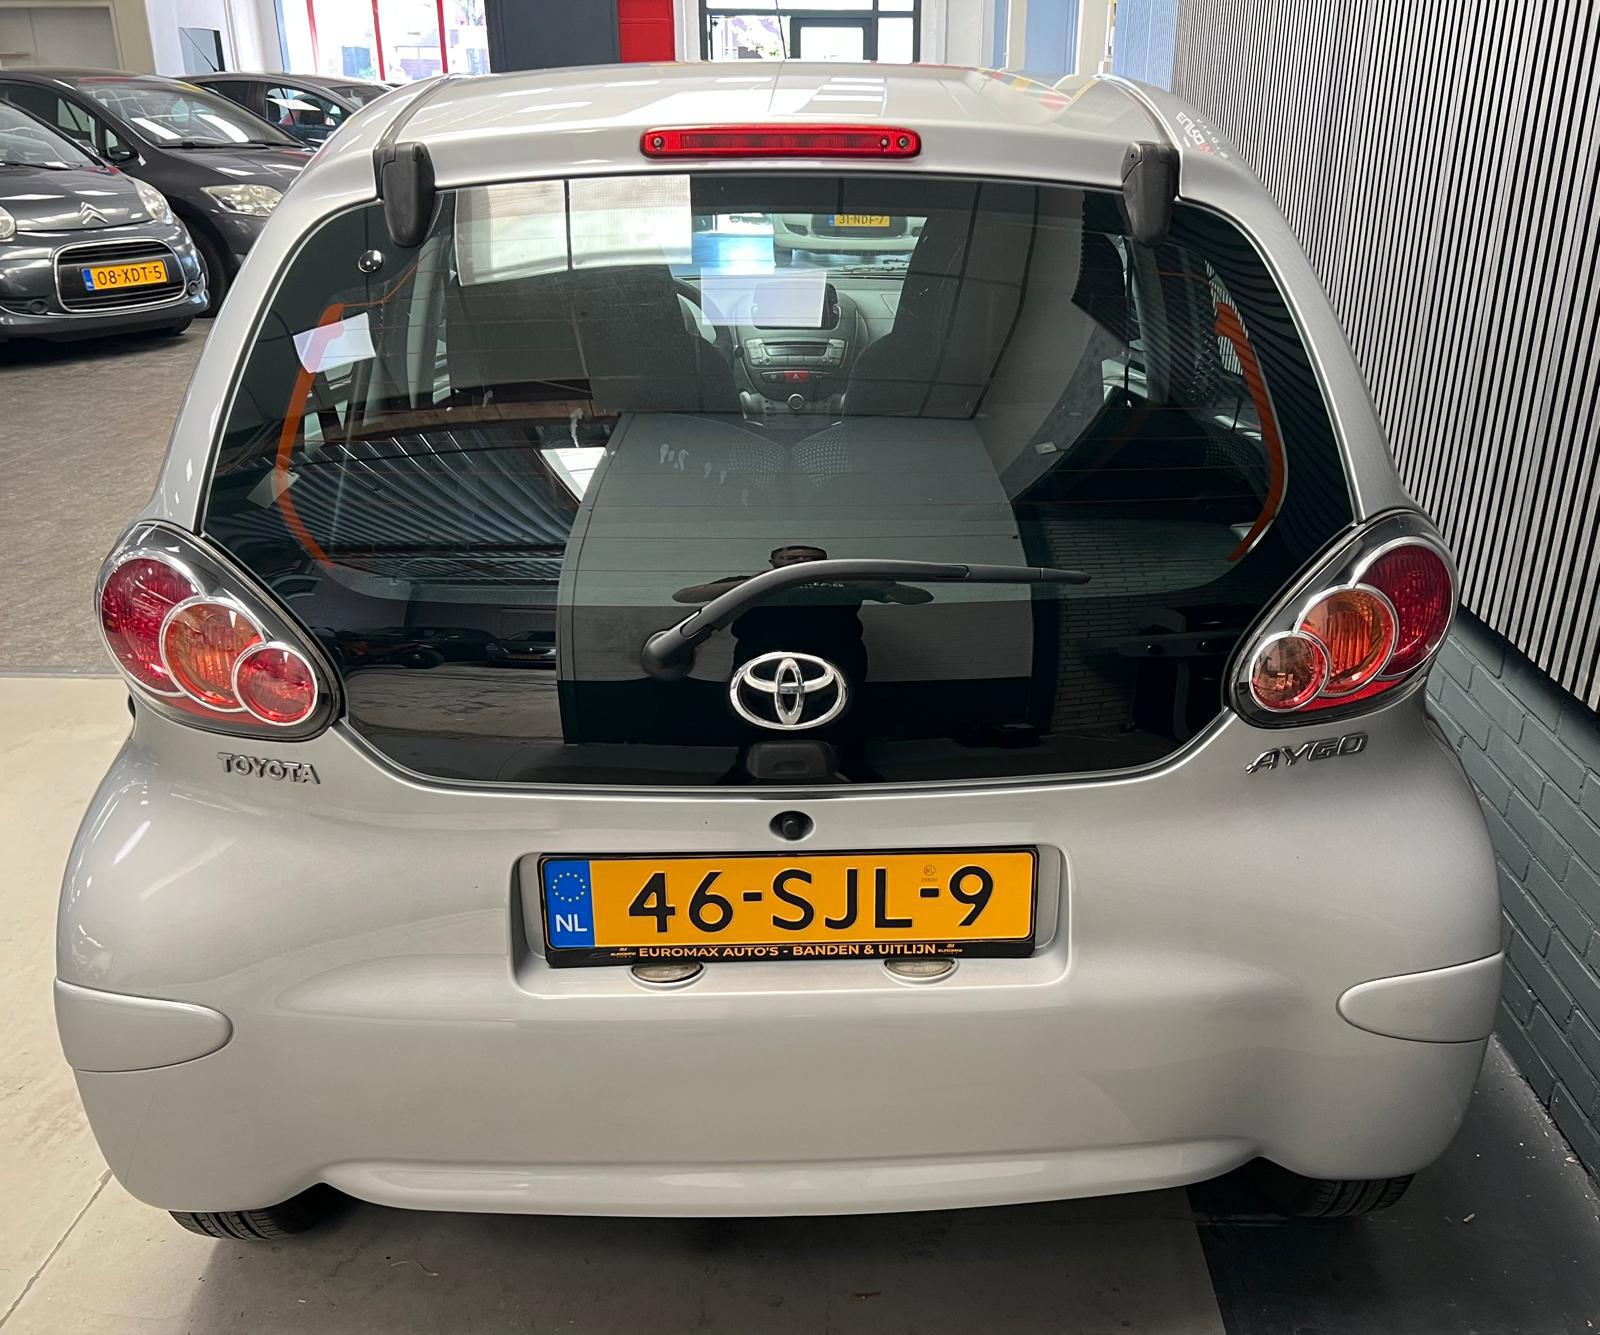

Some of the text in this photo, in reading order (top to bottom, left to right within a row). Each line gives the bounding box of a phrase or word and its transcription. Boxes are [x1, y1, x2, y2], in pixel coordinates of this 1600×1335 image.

[97, 265, 162, 285] 08-XDT-5
[1245, 732, 1368, 774] AYGO
[217, 751, 321, 785] TOYOTA
[628, 865, 994, 933] 46-SJL-9
[555, 914, 588, 933] NL
[639, 947, 719, 958] EUROMAX
[722, 946, 779, 957] AUTO'S
[792, 944, 859, 956] BANDEN
[863, 944, 874, 955] &
[878, 943, 936, 955] UITLIJN
